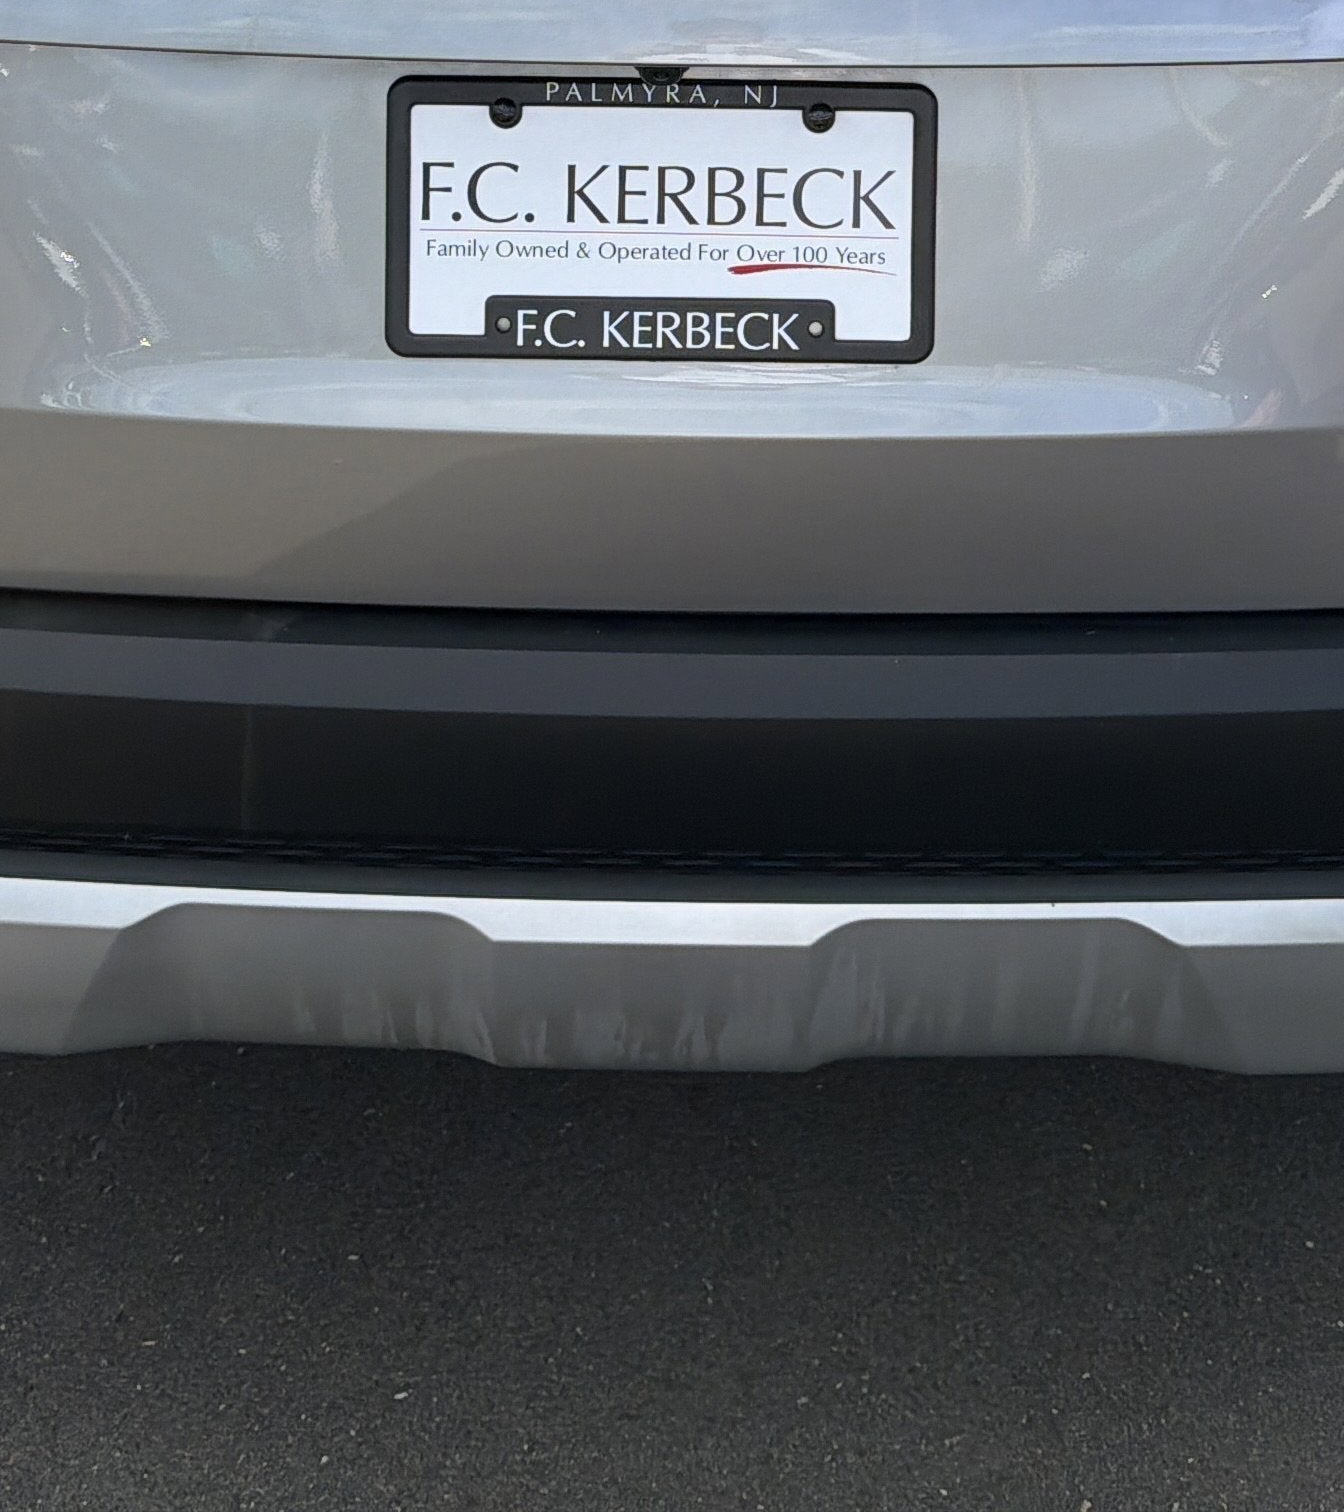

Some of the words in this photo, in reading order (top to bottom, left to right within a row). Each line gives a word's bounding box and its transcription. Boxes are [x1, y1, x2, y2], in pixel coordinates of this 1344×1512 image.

[545, 81, 720, 108] PALMYRA,
[744, 84, 778, 108] NJ
[420, 161, 536, 224] F.C.
[566, 164, 897, 230] KERBECK
[426, 238, 490, 261] Family
[495, 239, 569, 259] Owned
[575, 242, 591, 260] &
[598, 241, 692, 264] Operated
[698, 244, 729, 262] For
[736, 245, 786, 264] Over
[791, 246, 828, 264] 100
[835, 246, 886, 265] Years
[516, 309, 586, 349] F.C.
[602, 310, 800, 351] KERBECK
